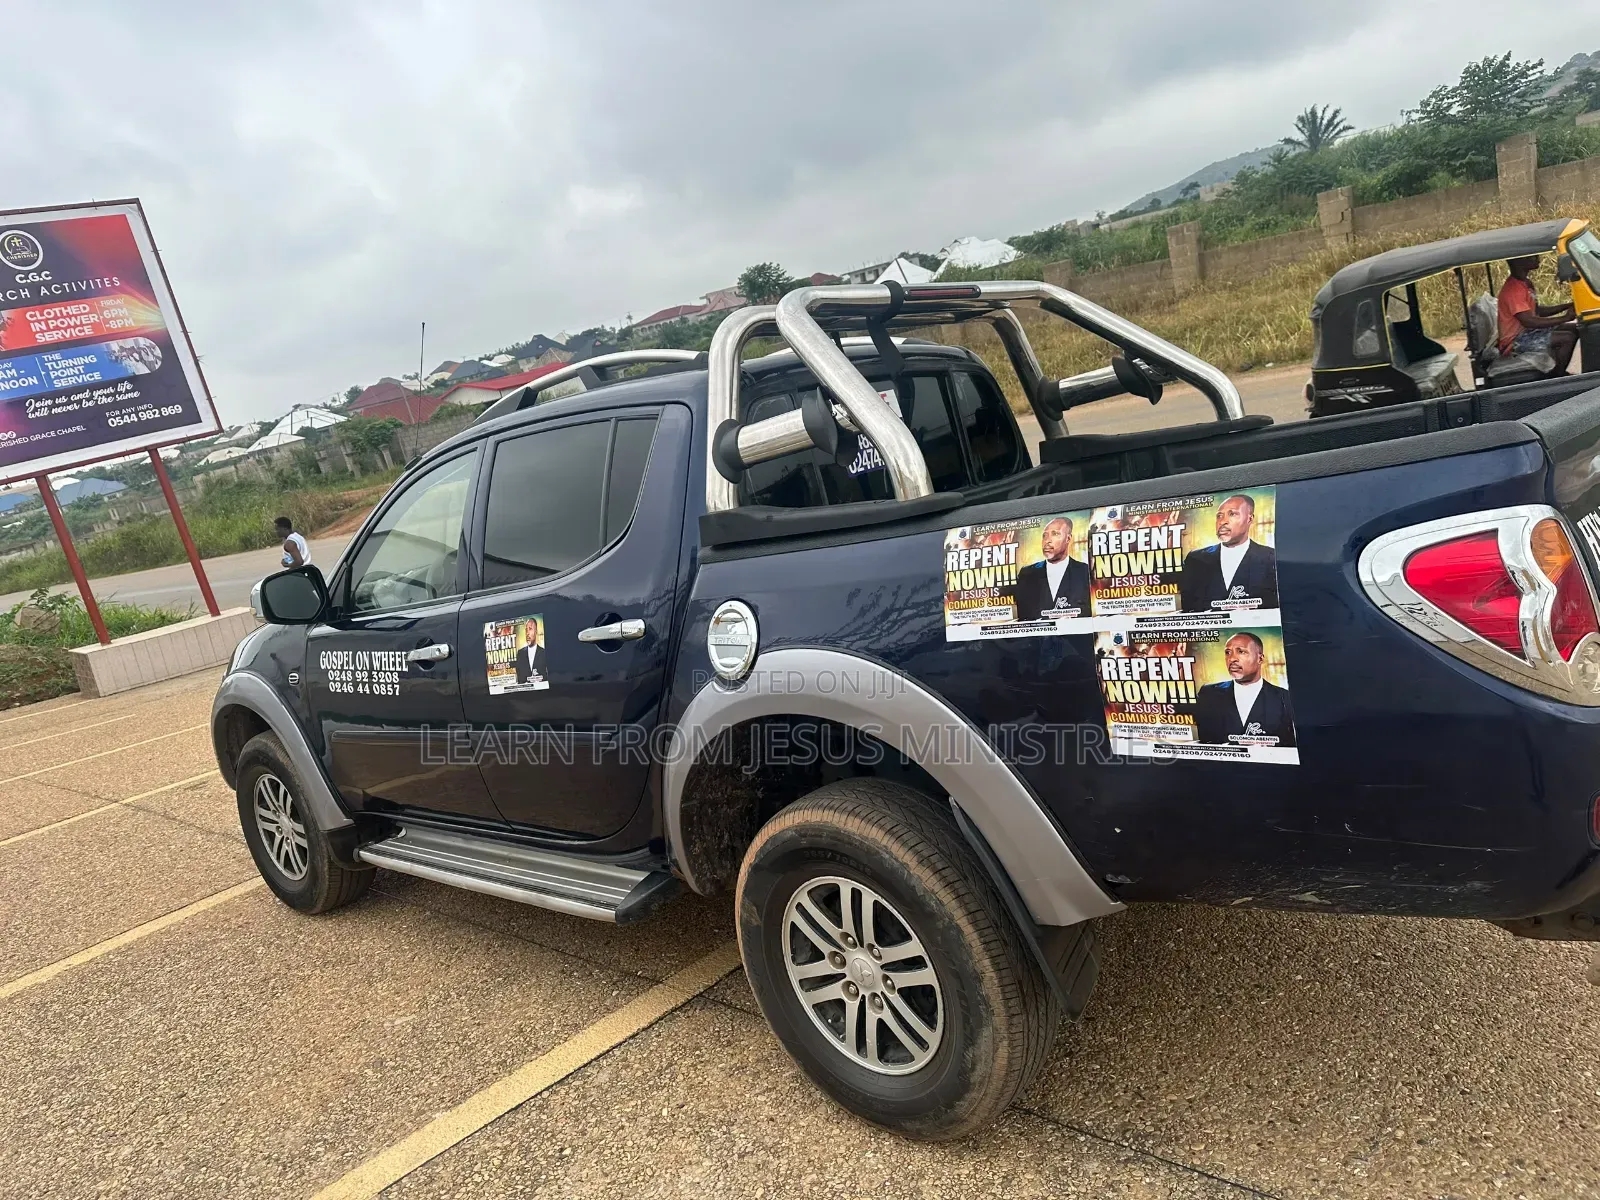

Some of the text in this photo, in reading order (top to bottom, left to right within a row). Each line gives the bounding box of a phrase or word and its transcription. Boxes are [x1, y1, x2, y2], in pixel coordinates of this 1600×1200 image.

[15, 270, 53, 284] C.G.C
[40, 276, 121, 297] ACTIVITES
[25, 303, 90, 321] CLOTHED
[103, 307, 129, 320] 6PM
[30, 313, 100, 333] IN POWER
[35, 325, 95, 343] SERVICE
[42, 353, 62, 362] THE
[45, 355, 97, 371] TURNING
[50, 365, 85, 379] POINT
[54, 371, 102, 388] SERVICE
[25, 379, 134, 415] Join us and your life
[27, 390, 141, 419] will never be the same
[105, 403, 154, 418] FOR ANY INFO
[107, 404, 183, 428] 0544 982 869
[29, 430, 57, 442] GRACE
[56, 424, 87, 436] CHAPEL
[1126, 495, 1214, 513] LEARN FROM JESUS
[996, 521, 1018, 530] FROM
[1092, 524, 1186, 556] REPENT
[946, 542, 1019, 571] REPENT
[1095, 548, 1183, 579] NOW!!!
[947, 564, 1018, 592] NOW!!!
[1110, 574, 1161, 588] JESUS IS
[959, 587, 1001, 600] JESUS IS
[1096, 583, 1178, 599] COMING SOON
[948, 595, 1015, 610] COMING SOON
[485, 634, 516, 651] REPENT
[1161, 631, 1189, 639] FROM
[1190, 630, 1220, 638] JESUS
[320, 650, 409, 672] GOSPEL ON WHEEL
[488, 648, 517, 664] NOW!!!
[328, 670, 400, 683] 0248 92 3208
[1100, 657, 1196, 681] REPENT
[329, 682, 400, 696] 0246 44 0857
[1105, 680, 1197, 704] NOW!!!
[1123, 703, 1175, 714] JESUS IS
[1110, 712, 1194, 725] COMING SOON
